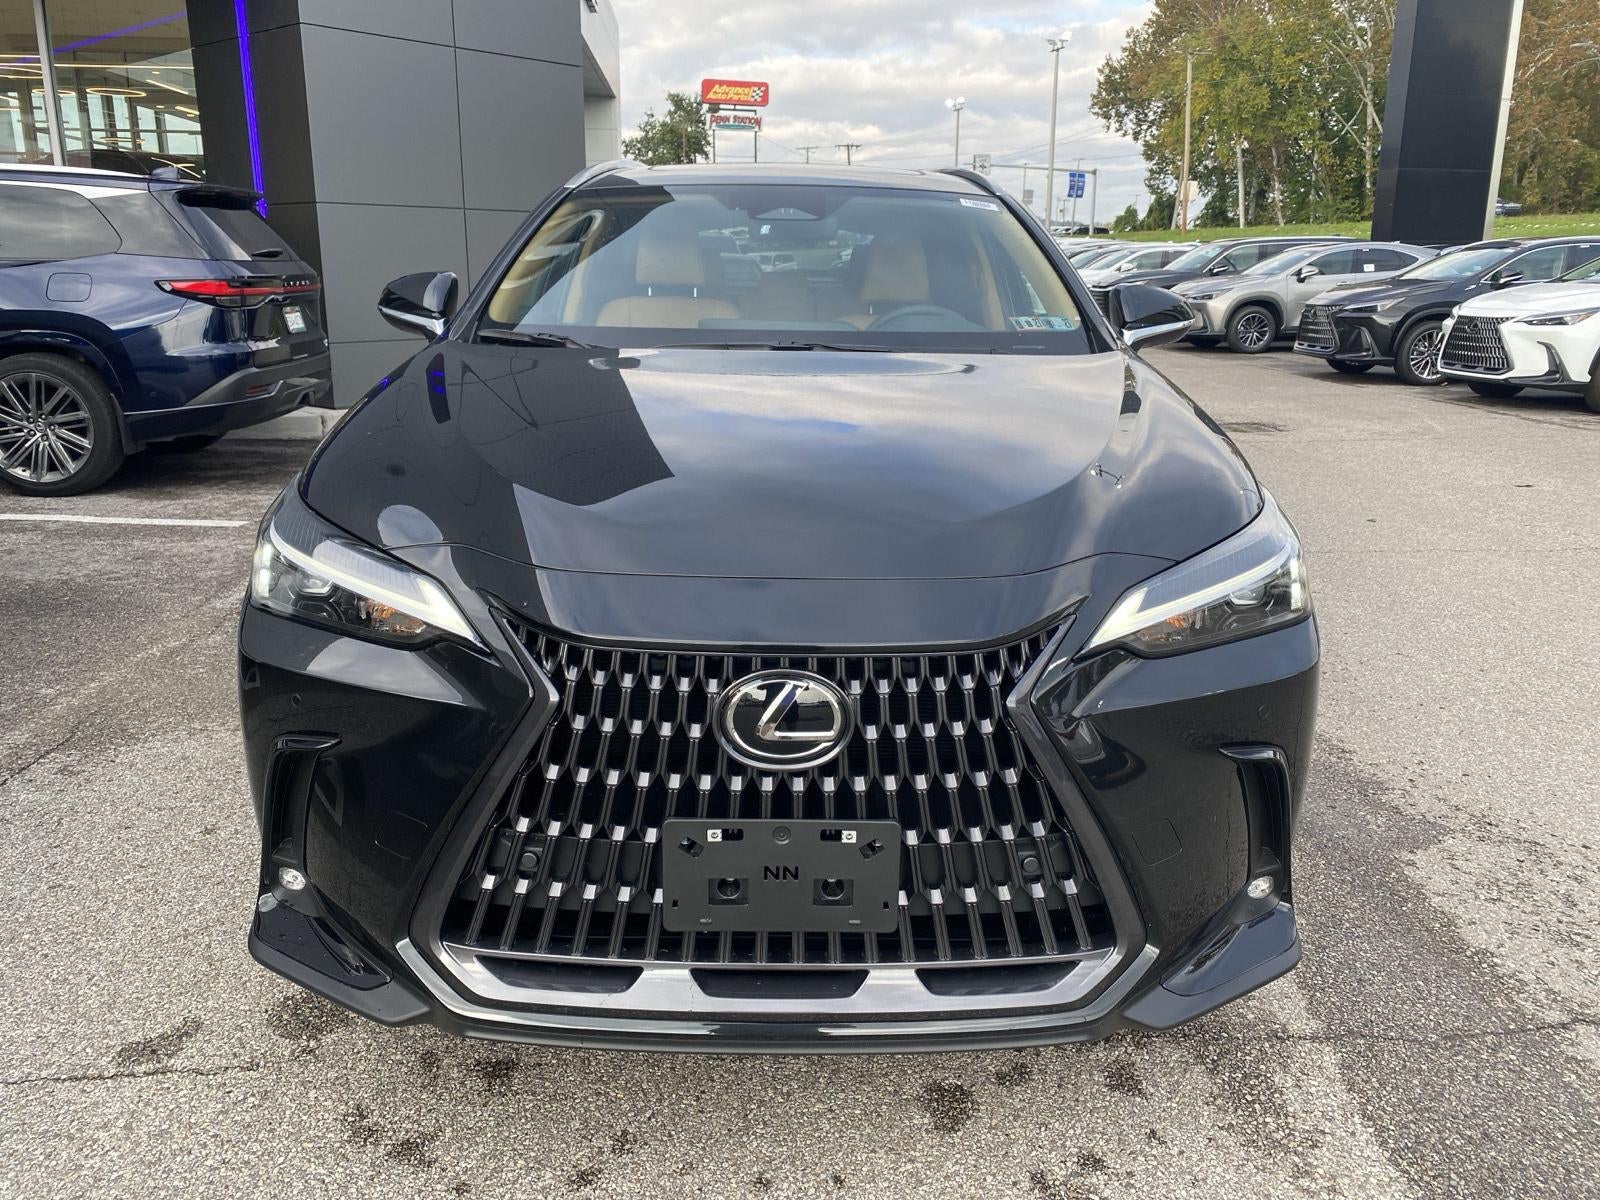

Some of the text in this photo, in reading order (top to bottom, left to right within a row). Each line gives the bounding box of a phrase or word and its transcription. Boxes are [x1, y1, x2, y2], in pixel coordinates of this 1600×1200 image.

[712, 84, 750, 95] Advance
[706, 91, 749, 101] Auto Parts
[763, 866, 799, 881] NN
